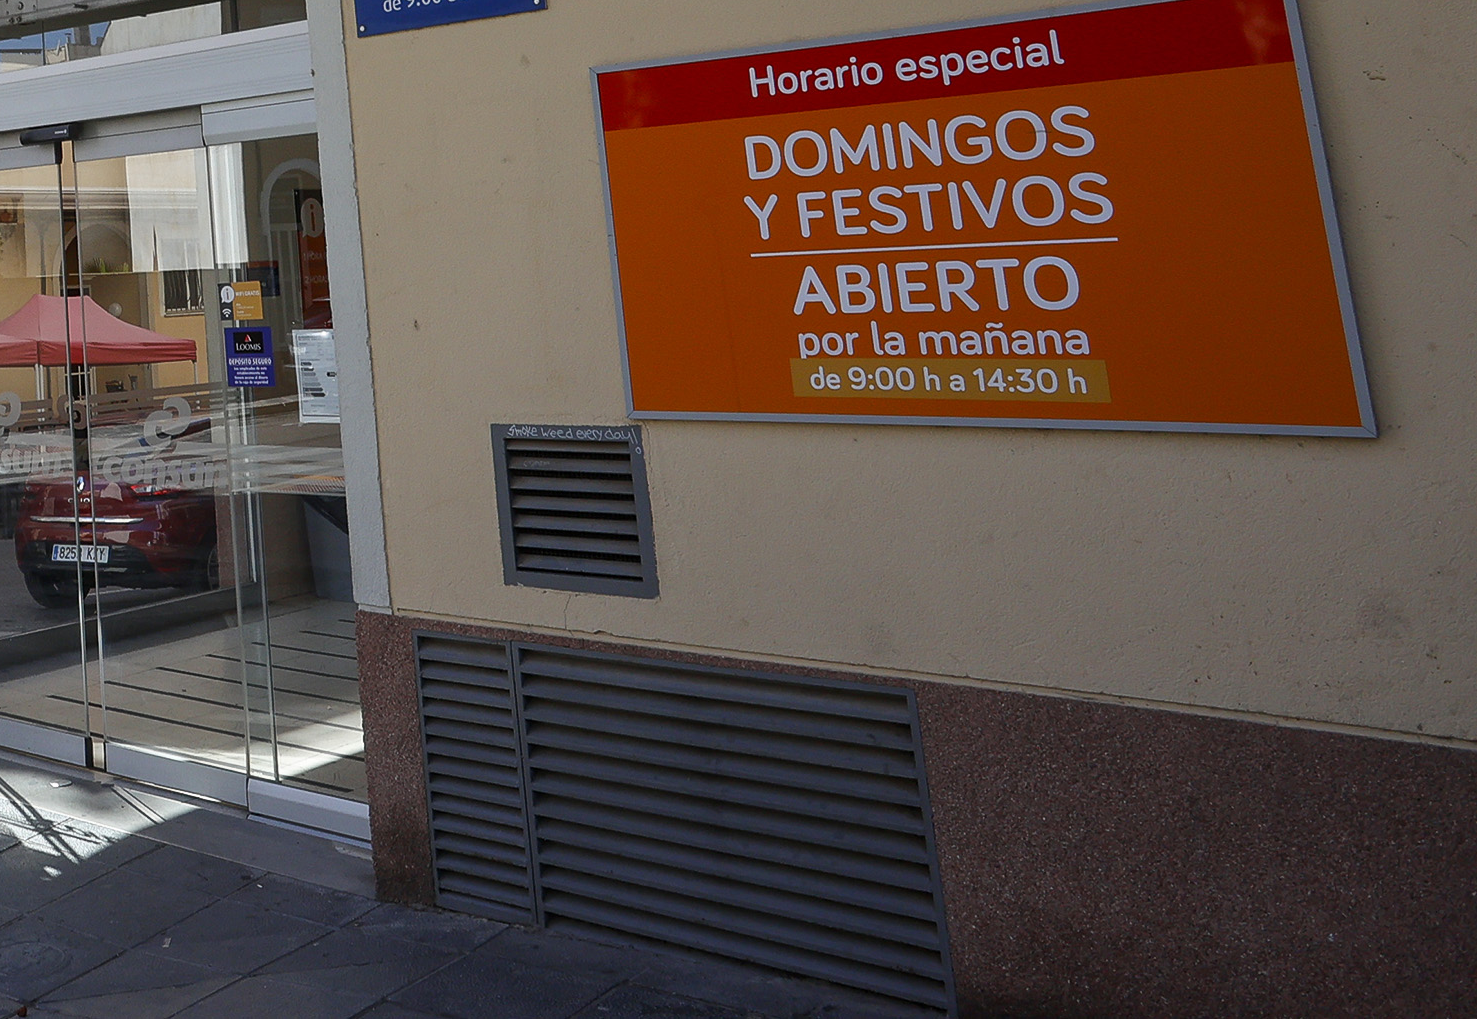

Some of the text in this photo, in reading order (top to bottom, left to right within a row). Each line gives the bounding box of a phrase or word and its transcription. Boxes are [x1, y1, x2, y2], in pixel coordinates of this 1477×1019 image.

[749, 29, 1065, 98] Horario especial
[744, 105, 1095, 180] DOMINGOS
[743, 172, 1114, 240] Y FESTIVOS
[793, 256, 1080, 315] ABIERTO
[235, 343, 261, 351] LOOMIS
[798, 320, 1090, 359] por la mañana
[809, 366, 1087, 394] de 9:00 h a 14:30 h
[576, 428, 603, 441] every
